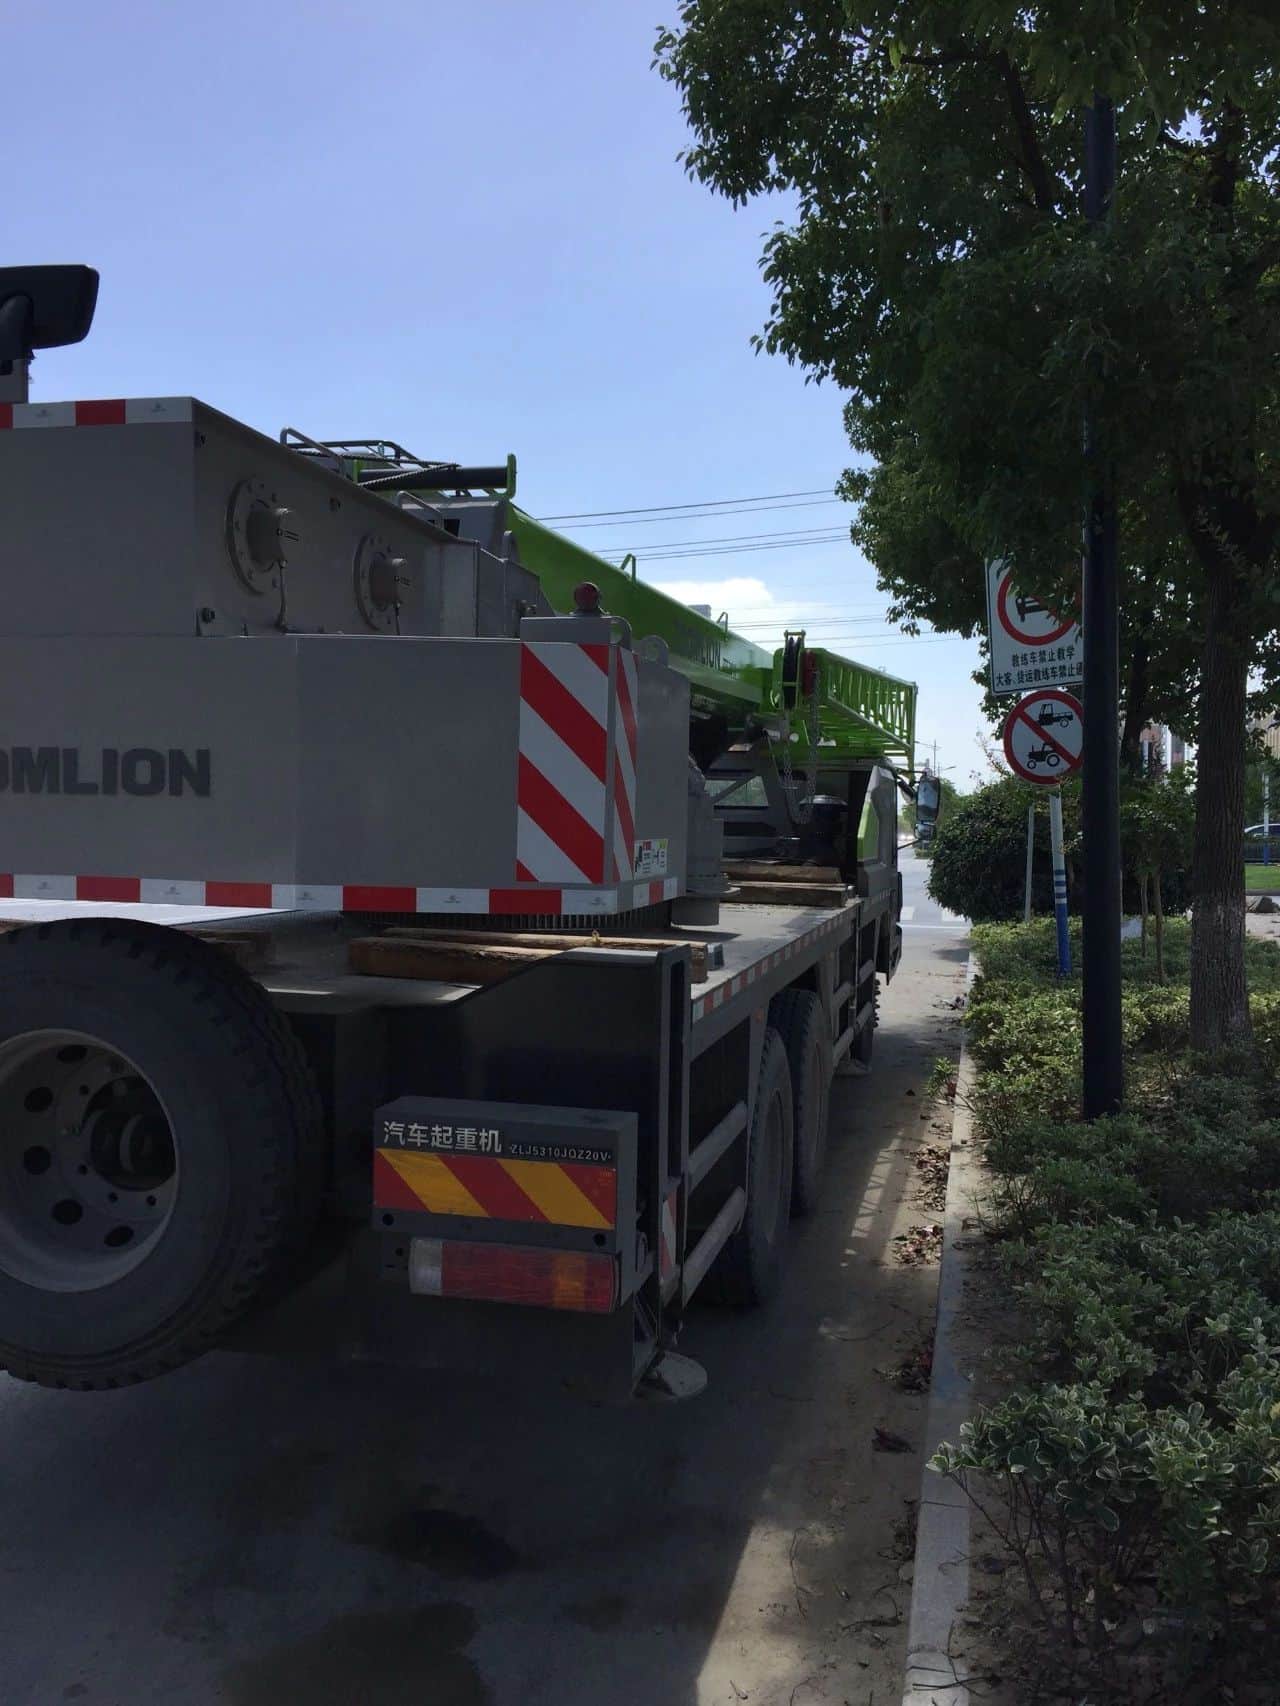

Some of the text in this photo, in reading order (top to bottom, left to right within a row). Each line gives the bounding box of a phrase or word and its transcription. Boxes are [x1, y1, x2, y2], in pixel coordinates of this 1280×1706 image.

[0, 746, 211, 797] MLION
[383, 1120, 502, 1153] 汽车起重机
